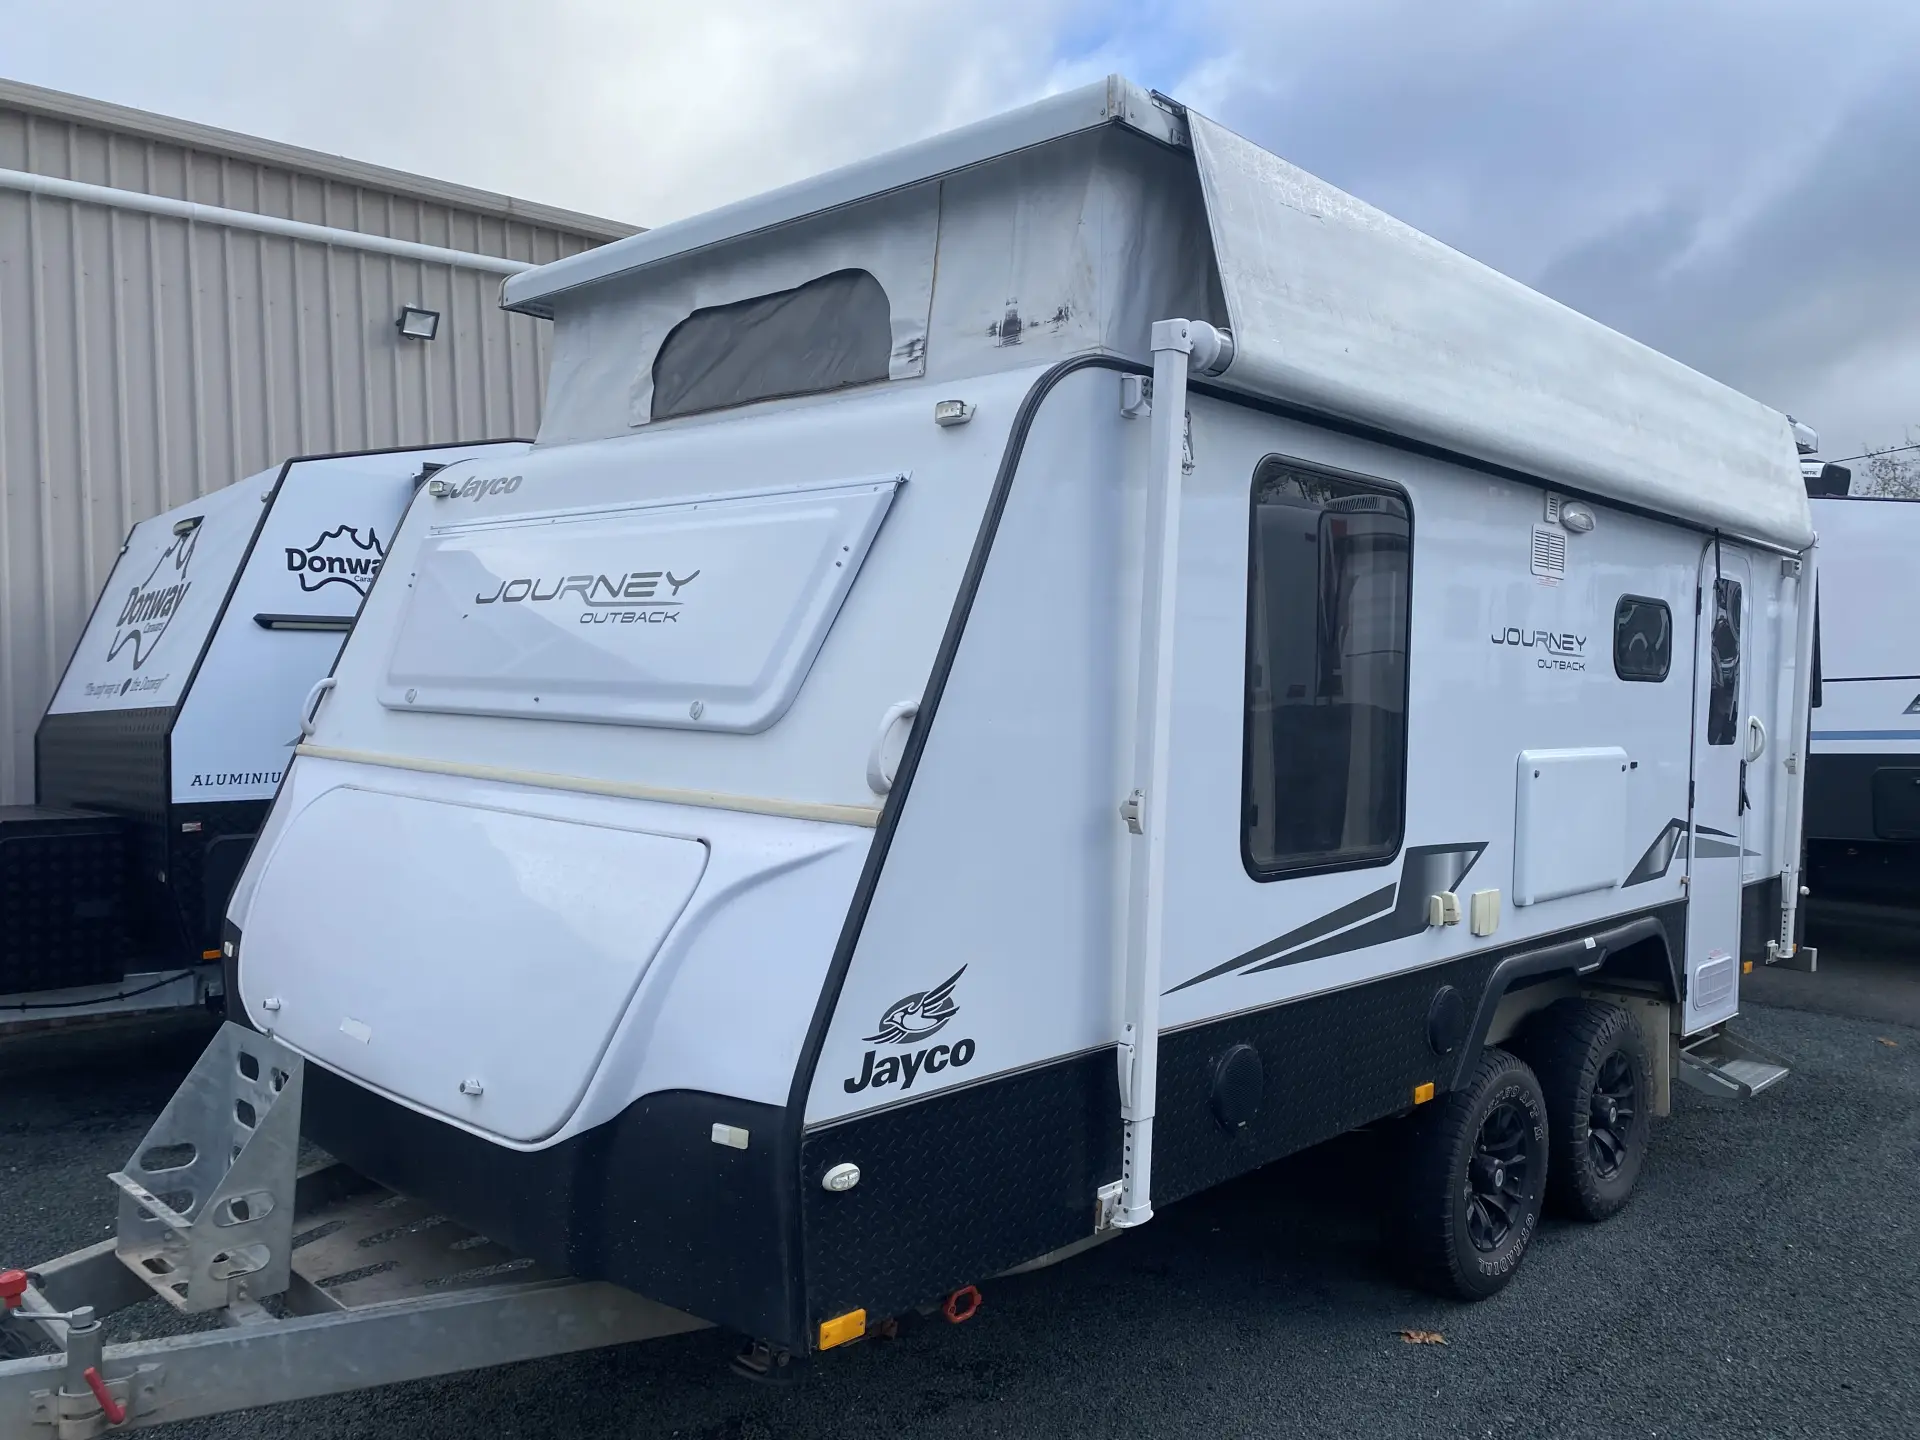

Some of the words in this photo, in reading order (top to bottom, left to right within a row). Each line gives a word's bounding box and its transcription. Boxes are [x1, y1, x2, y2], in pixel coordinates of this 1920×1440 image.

[450, 475, 523, 502] Jayco
[475, 569, 701, 606] JOURNEY
[116, 581, 192, 627] Donway
[580, 611, 680, 624] OUTBACK
[1491, 627, 1587, 655] JOURNEY
[1537, 659, 1586, 671] OUTBACK
[190, 772, 282, 786] ALUMINIU
[843, 1038, 976, 1094] Jayco
[1478, 1239, 1523, 1276] RADIAL
